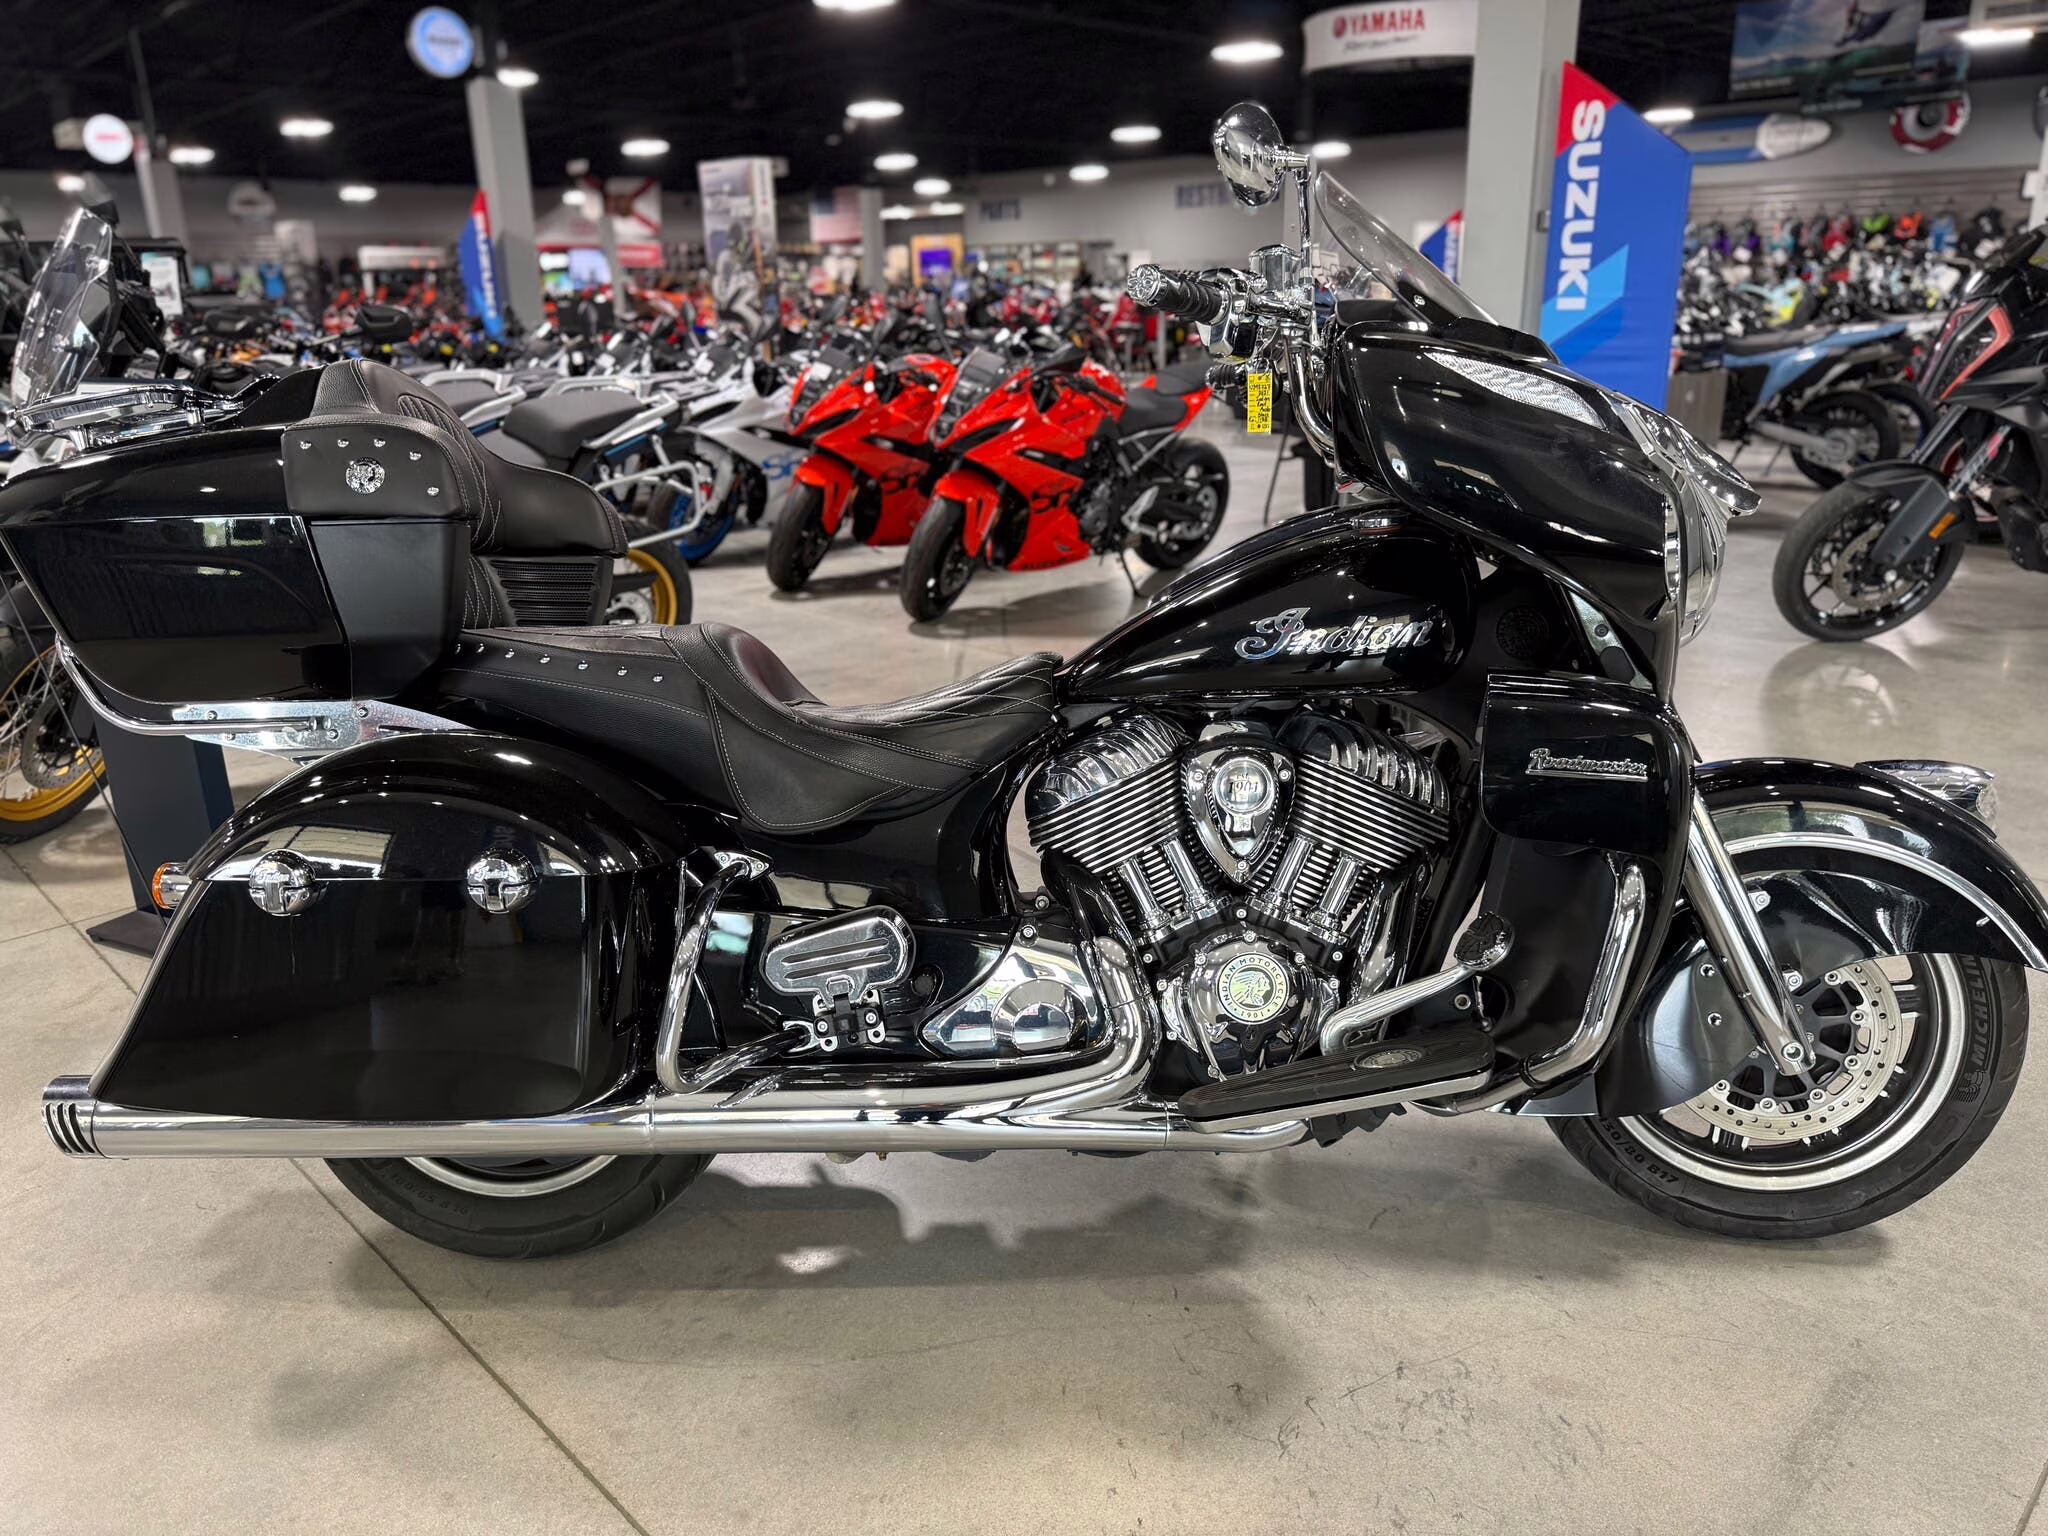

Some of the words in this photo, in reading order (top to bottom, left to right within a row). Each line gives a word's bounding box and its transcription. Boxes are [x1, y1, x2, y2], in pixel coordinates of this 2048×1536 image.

[1351, 8, 1425, 35] YAMAHA
[1556, 99, 1606, 311] SUZUKI
[1234, 607, 1434, 660] Indian
[1228, 781, 1259, 794] 1901
[1527, 747, 1649, 776] Roadmaster
[1221, 965, 1236, 1006] INDIAN
[1239, 956, 1284, 1008] MOTORCYCLE
[1960, 954, 1988, 1067] MICHELIN
